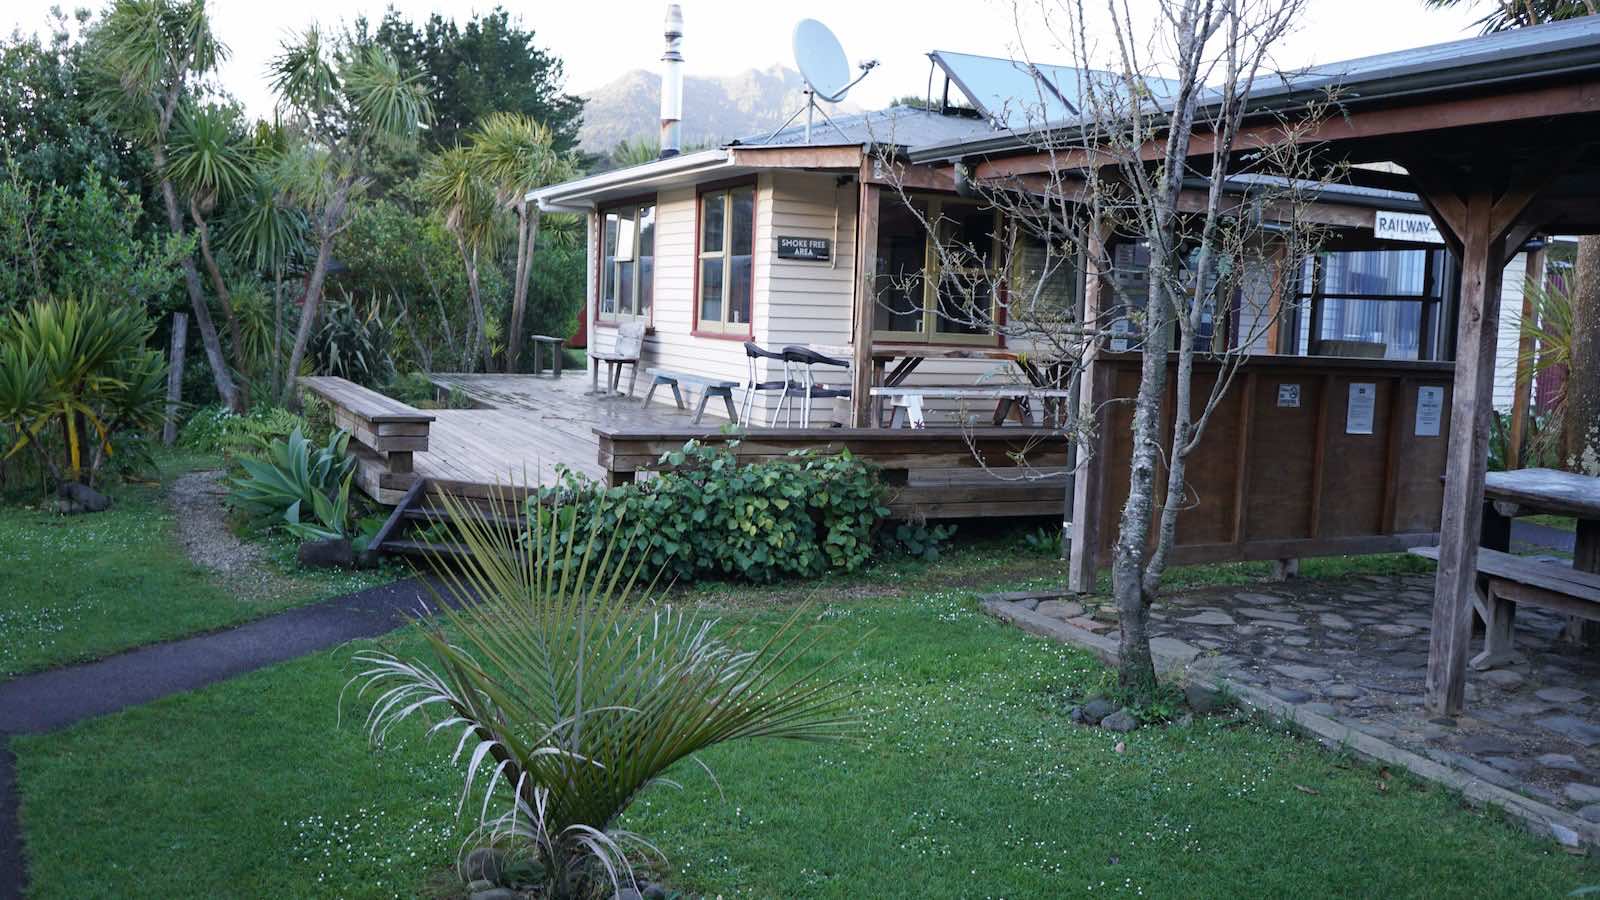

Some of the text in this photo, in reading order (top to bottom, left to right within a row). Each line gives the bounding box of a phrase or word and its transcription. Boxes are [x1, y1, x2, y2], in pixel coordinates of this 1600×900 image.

[781, 239, 826, 249] SMOKE FREE
[794, 247, 813, 256] AREA
